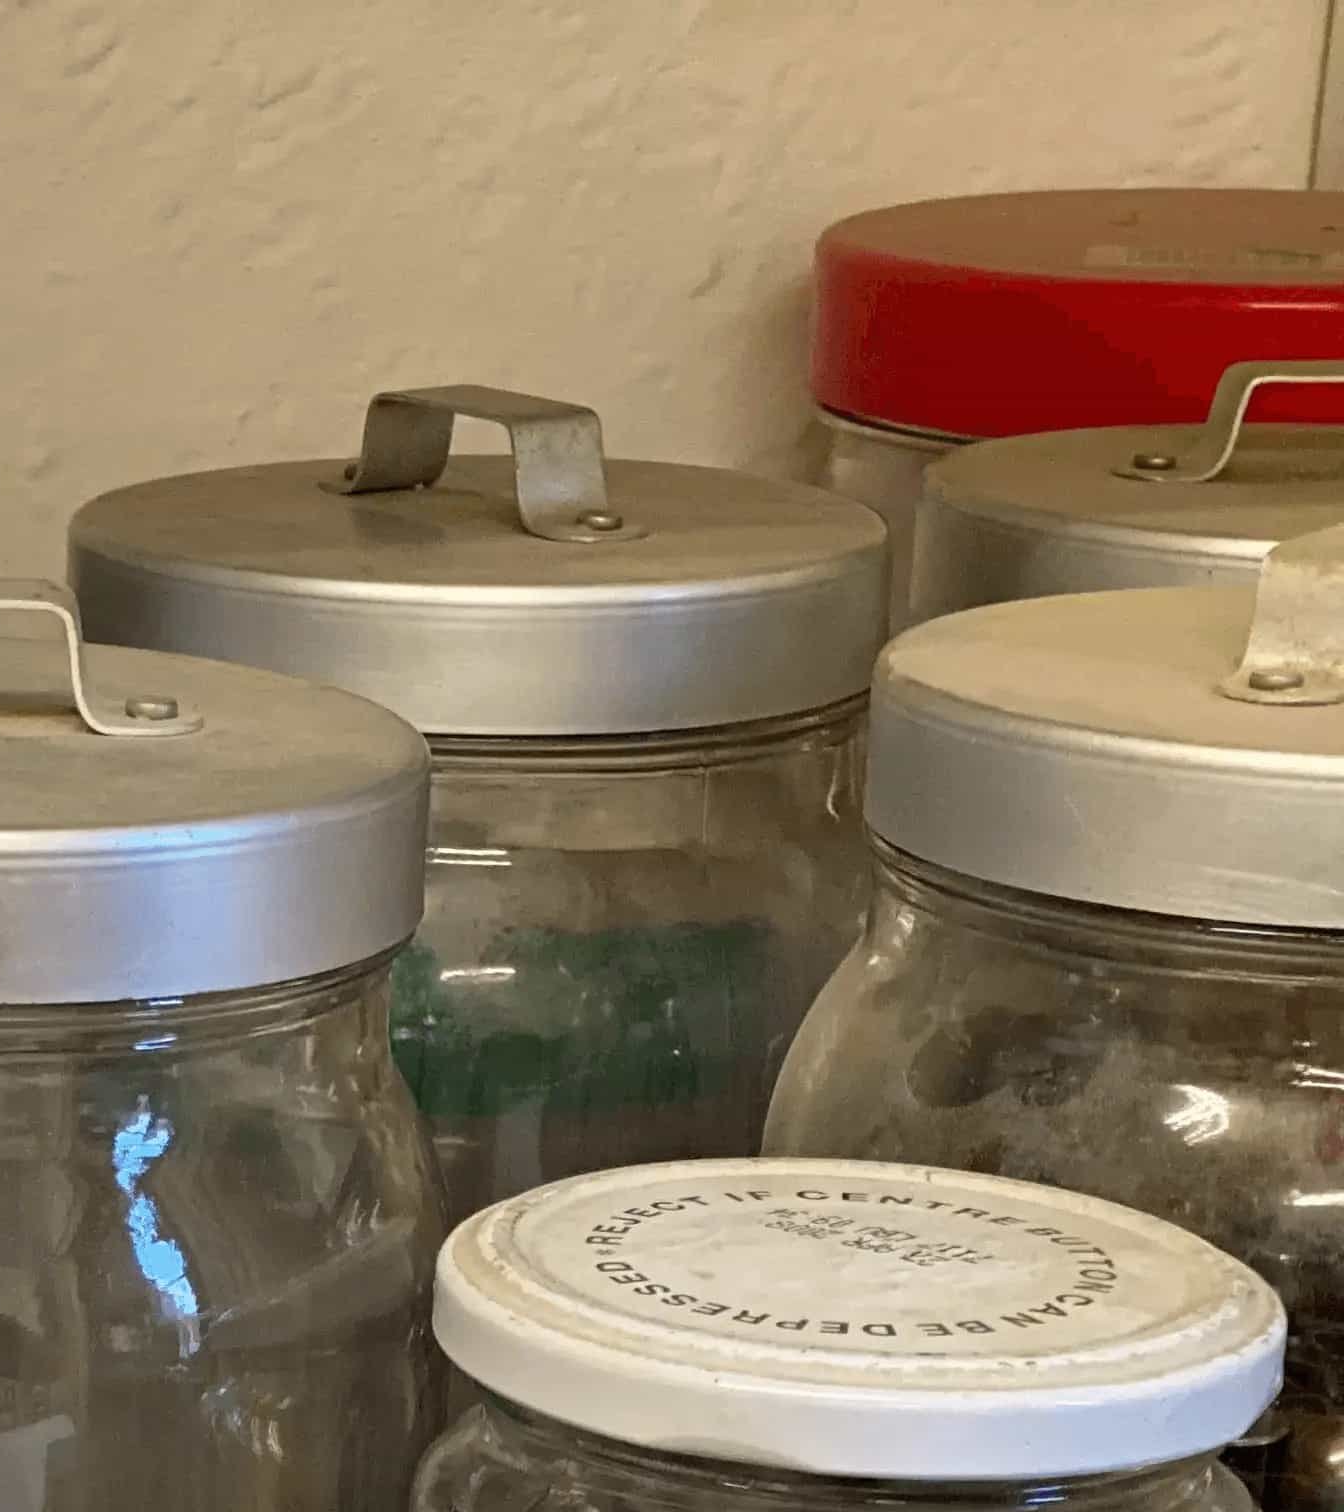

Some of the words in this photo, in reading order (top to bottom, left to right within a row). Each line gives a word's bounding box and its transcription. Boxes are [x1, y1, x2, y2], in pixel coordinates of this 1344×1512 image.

[723, 1189, 775, 1203] IF
[795, 1189, 1028, 1226] CENTRE
[585, 1195, 710, 1246] REJECT
[1023, 1226, 1118, 1294] BUTTON
[595, 1261, 897, 1338] DEPRESSED
[998, 1293, 1095, 1328] CAN
[914, 1319, 997, 1338] BE
